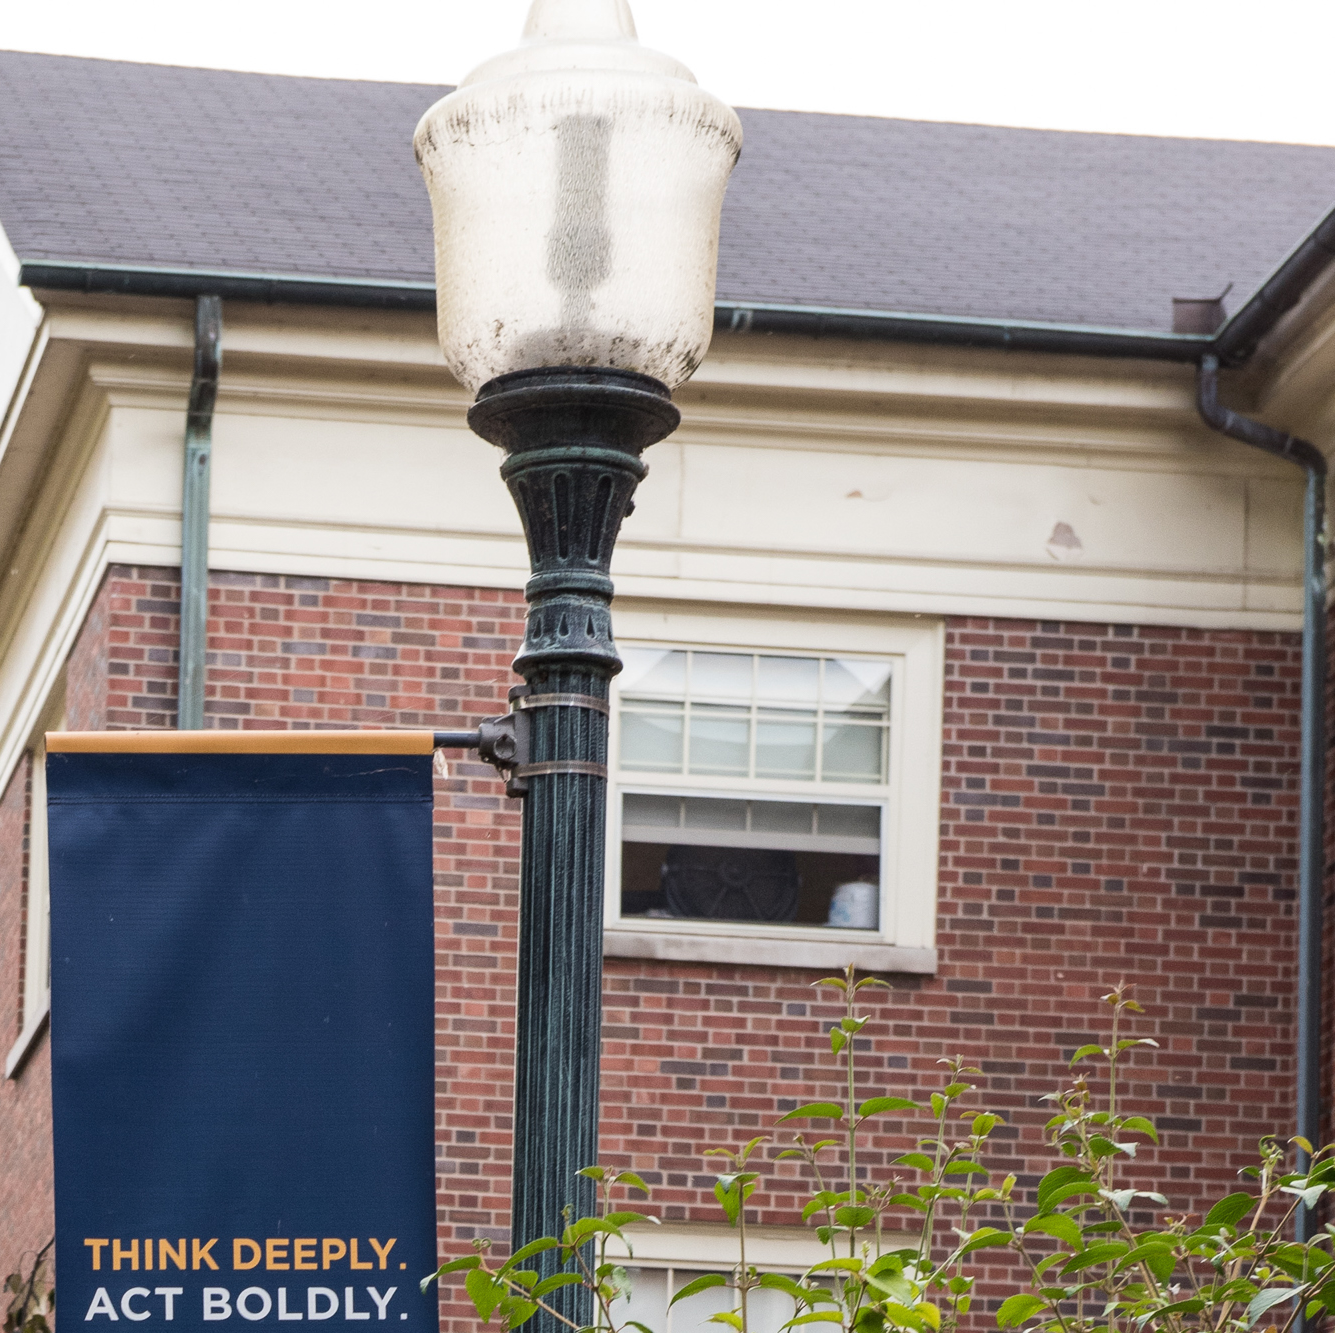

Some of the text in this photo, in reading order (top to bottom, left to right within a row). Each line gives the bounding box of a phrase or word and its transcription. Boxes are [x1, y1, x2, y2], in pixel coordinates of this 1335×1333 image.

[84, 1238, 407, 1270] THINK DEEPLY.
[84, 1286, 408, 1321] ACT BOLDLY.
